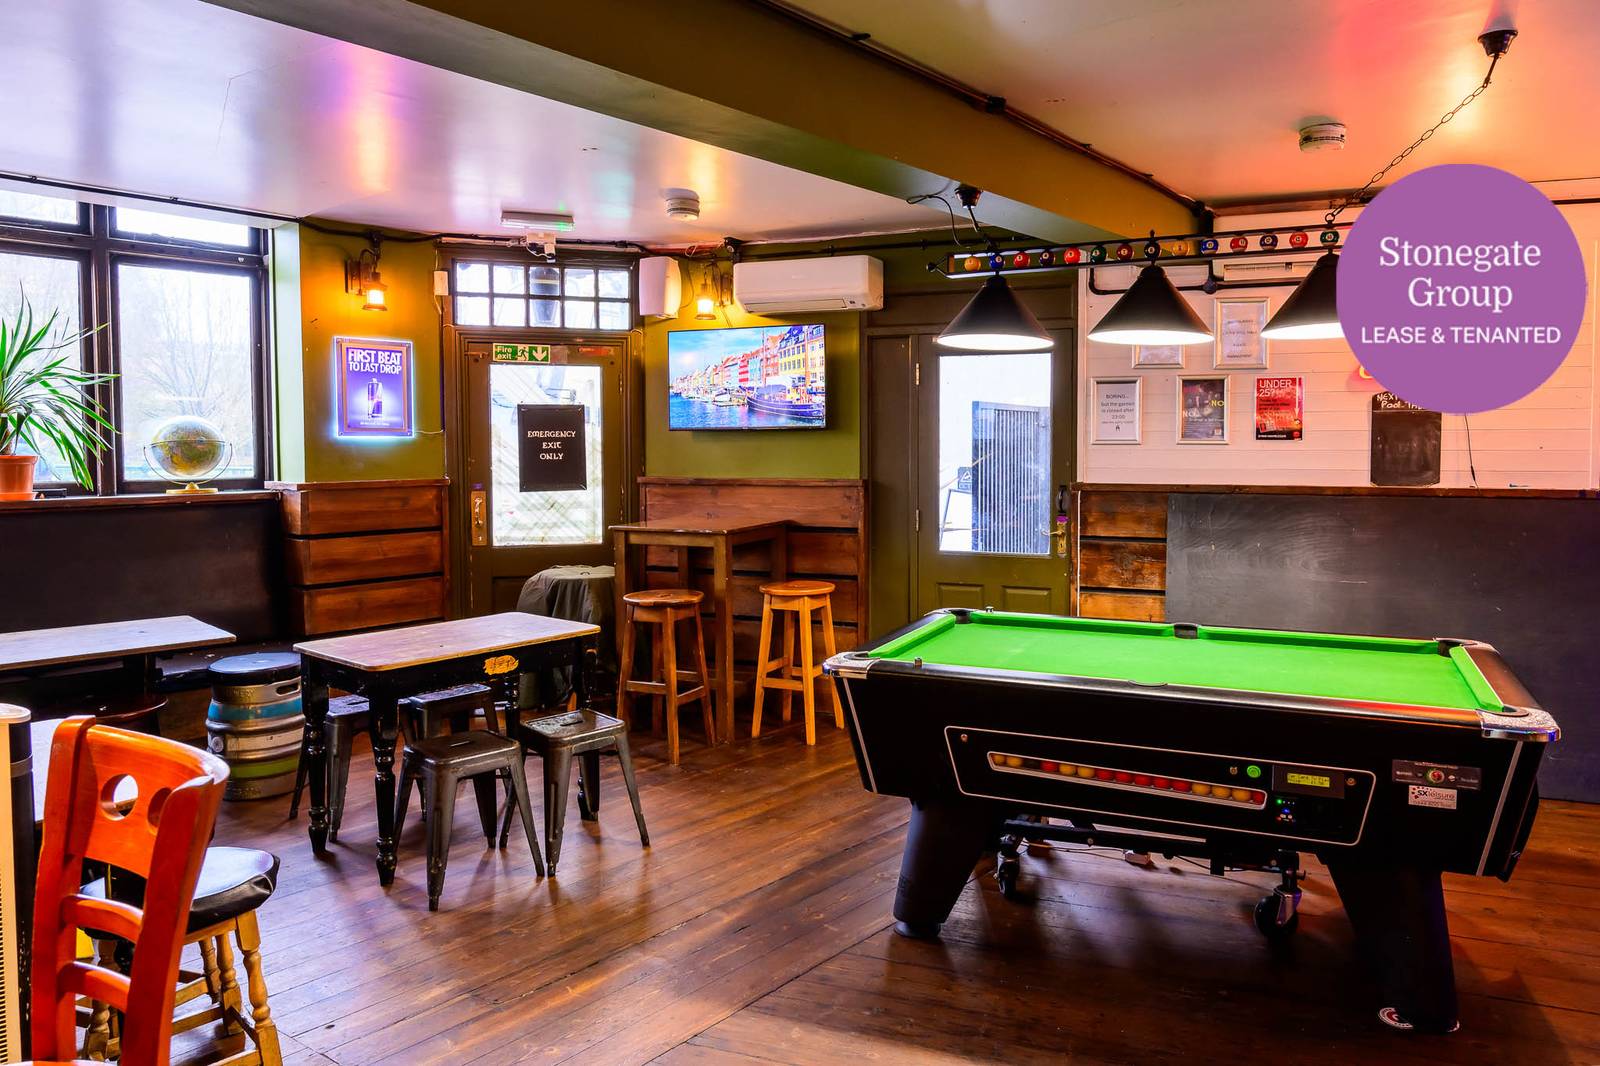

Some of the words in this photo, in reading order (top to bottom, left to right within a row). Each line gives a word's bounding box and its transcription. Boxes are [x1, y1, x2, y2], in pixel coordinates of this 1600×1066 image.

[497, 345, 512, 353] Fire
[348, 349, 376, 363] FIRST
[378, 351, 402, 366] BEAT
[349, 361, 360, 372] TO
[360, 362, 379, 373] LAST
[380, 364, 402, 375] DROP
[1259, 379, 1292, 389] UNDER
[527, 430, 577, 438] EMERGENCY
[542, 441, 562, 449] EXIT
[539, 452, 564, 460] ONLY
